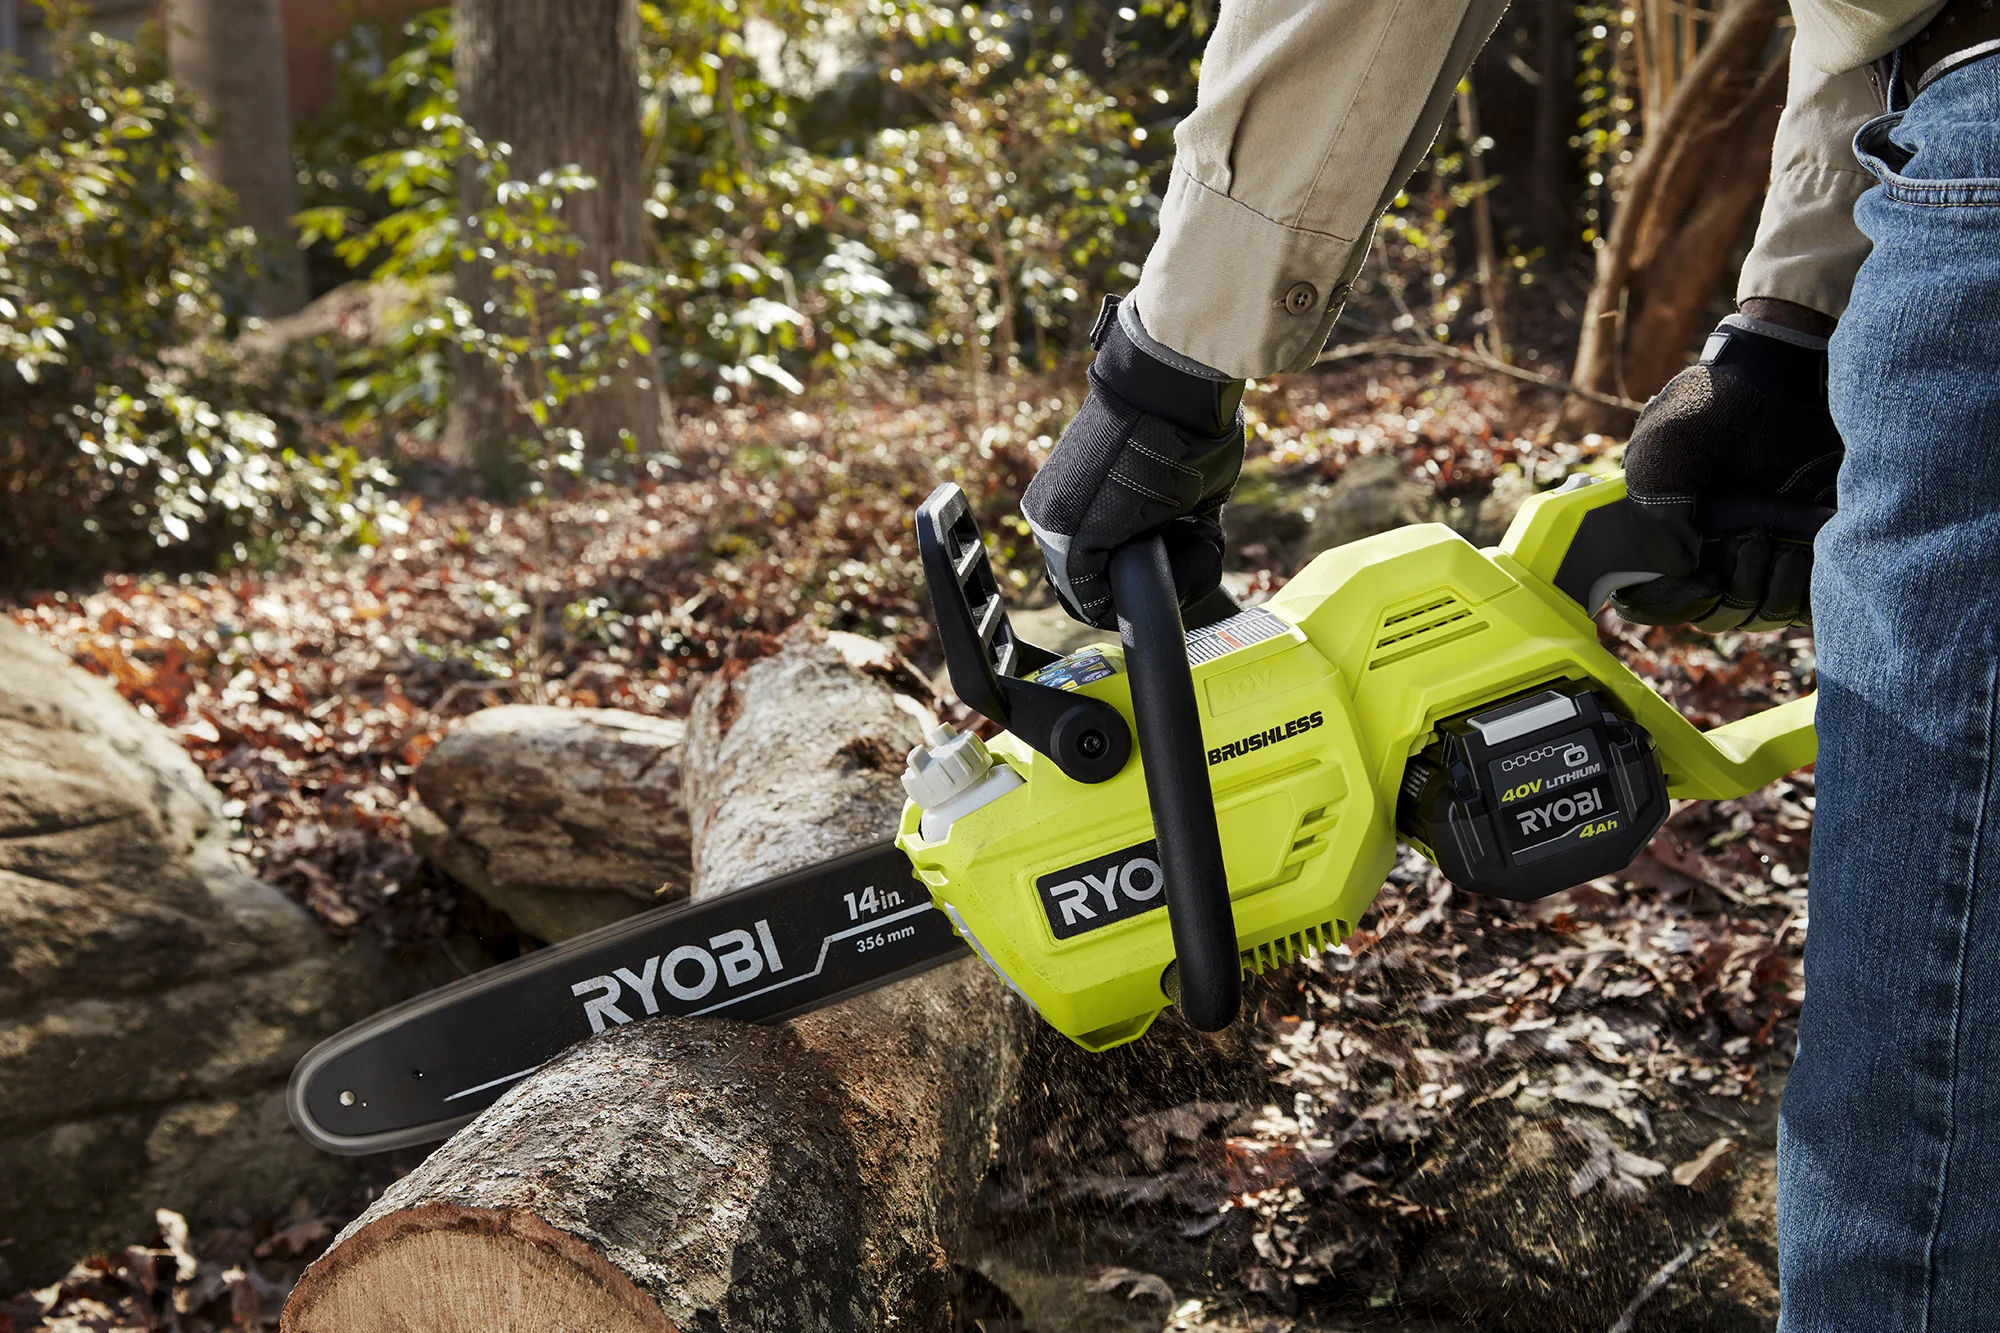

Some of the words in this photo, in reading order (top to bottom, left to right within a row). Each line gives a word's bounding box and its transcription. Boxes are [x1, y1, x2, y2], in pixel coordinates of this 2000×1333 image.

[1207, 711, 1324, 766] BRUSHLESS
[1501, 778, 1542, 802] 40V
[1546, 763, 1600, 789] LITHIUM
[1516, 788, 1602, 835] RYOBI
[1579, 820, 1617, 838] 4Ah
[1049, 857, 1164, 926] RYO
[856, 933, 885, 953] 356
[887, 925, 915, 943] mm
[571, 919, 783, 1033] RYOBI
